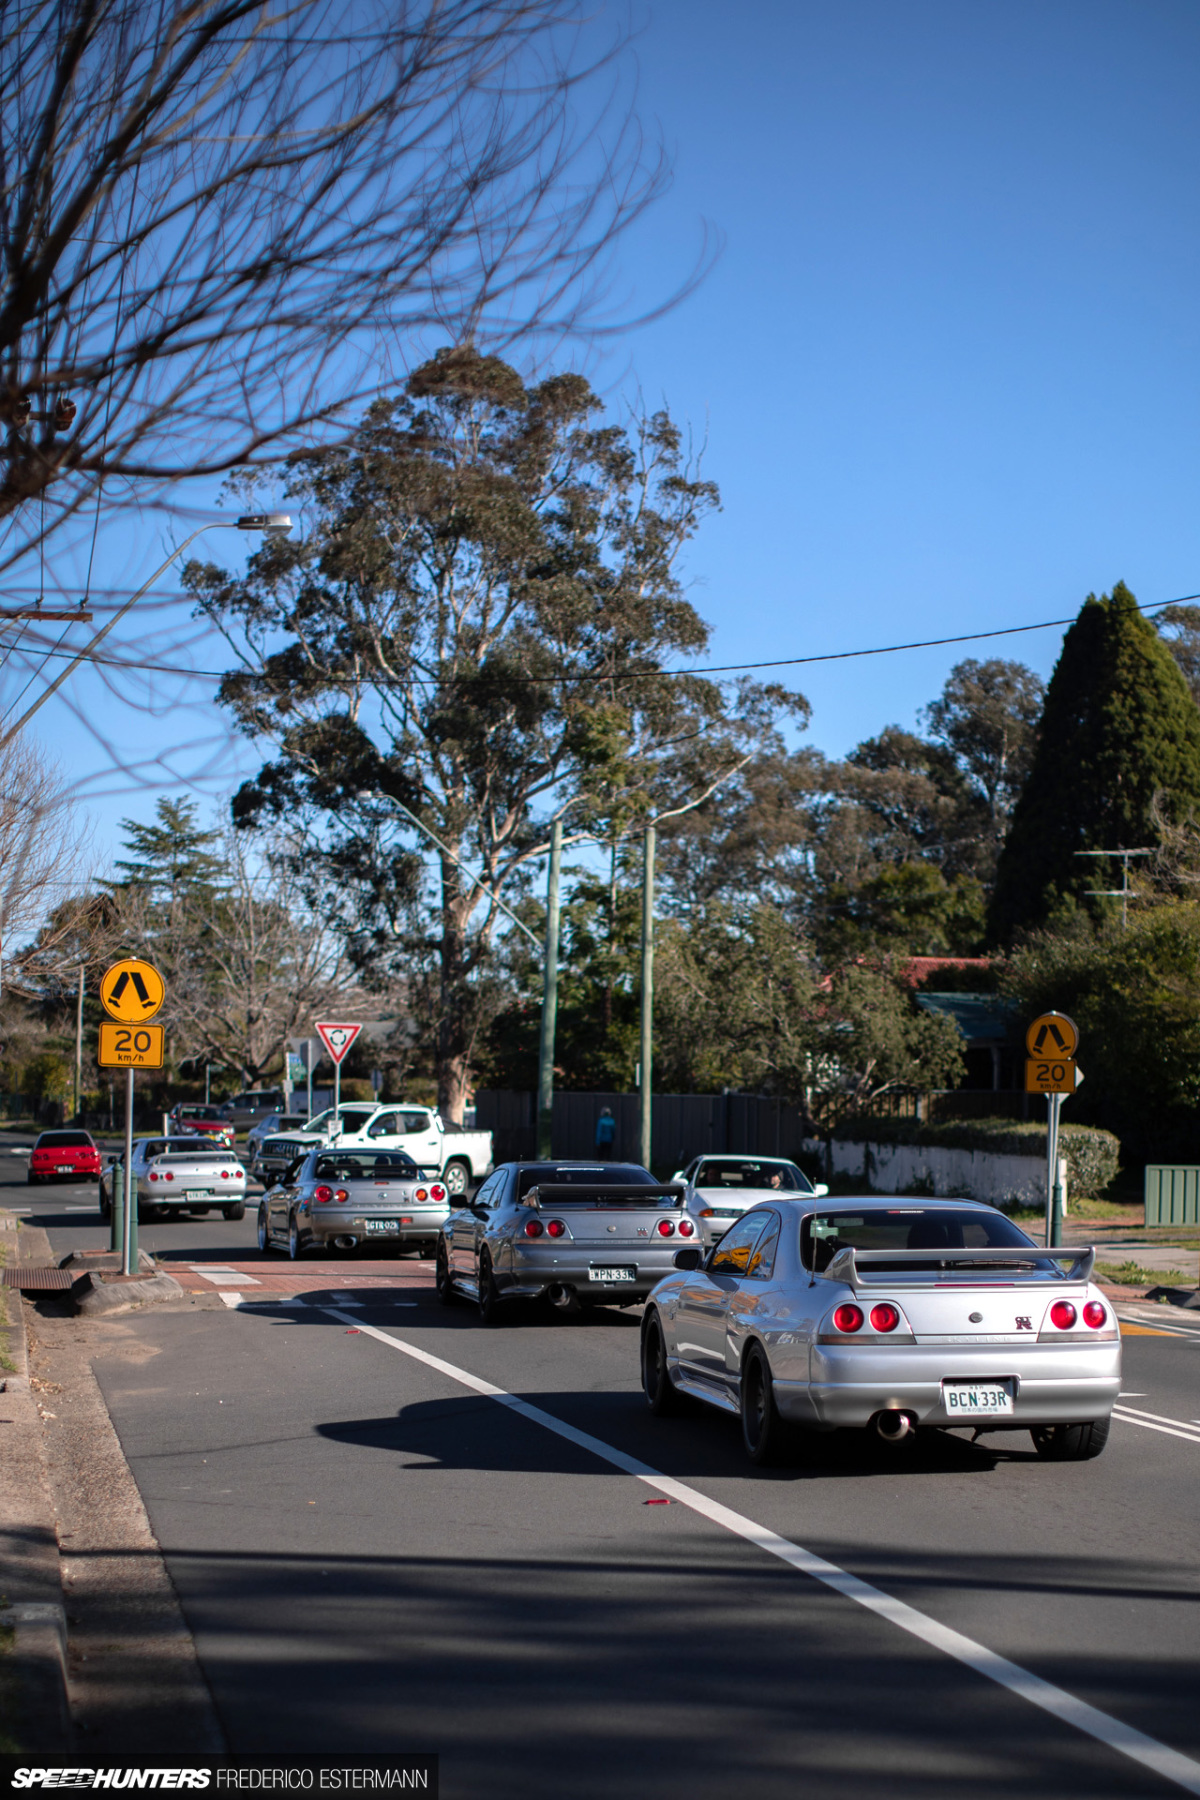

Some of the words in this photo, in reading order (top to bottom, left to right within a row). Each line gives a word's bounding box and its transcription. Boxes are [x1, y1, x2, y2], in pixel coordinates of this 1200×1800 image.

[114, 1030, 151, 1052] 20
[117, 1053, 144, 1062] km/h
[1036, 1064, 1065, 1082] 20
